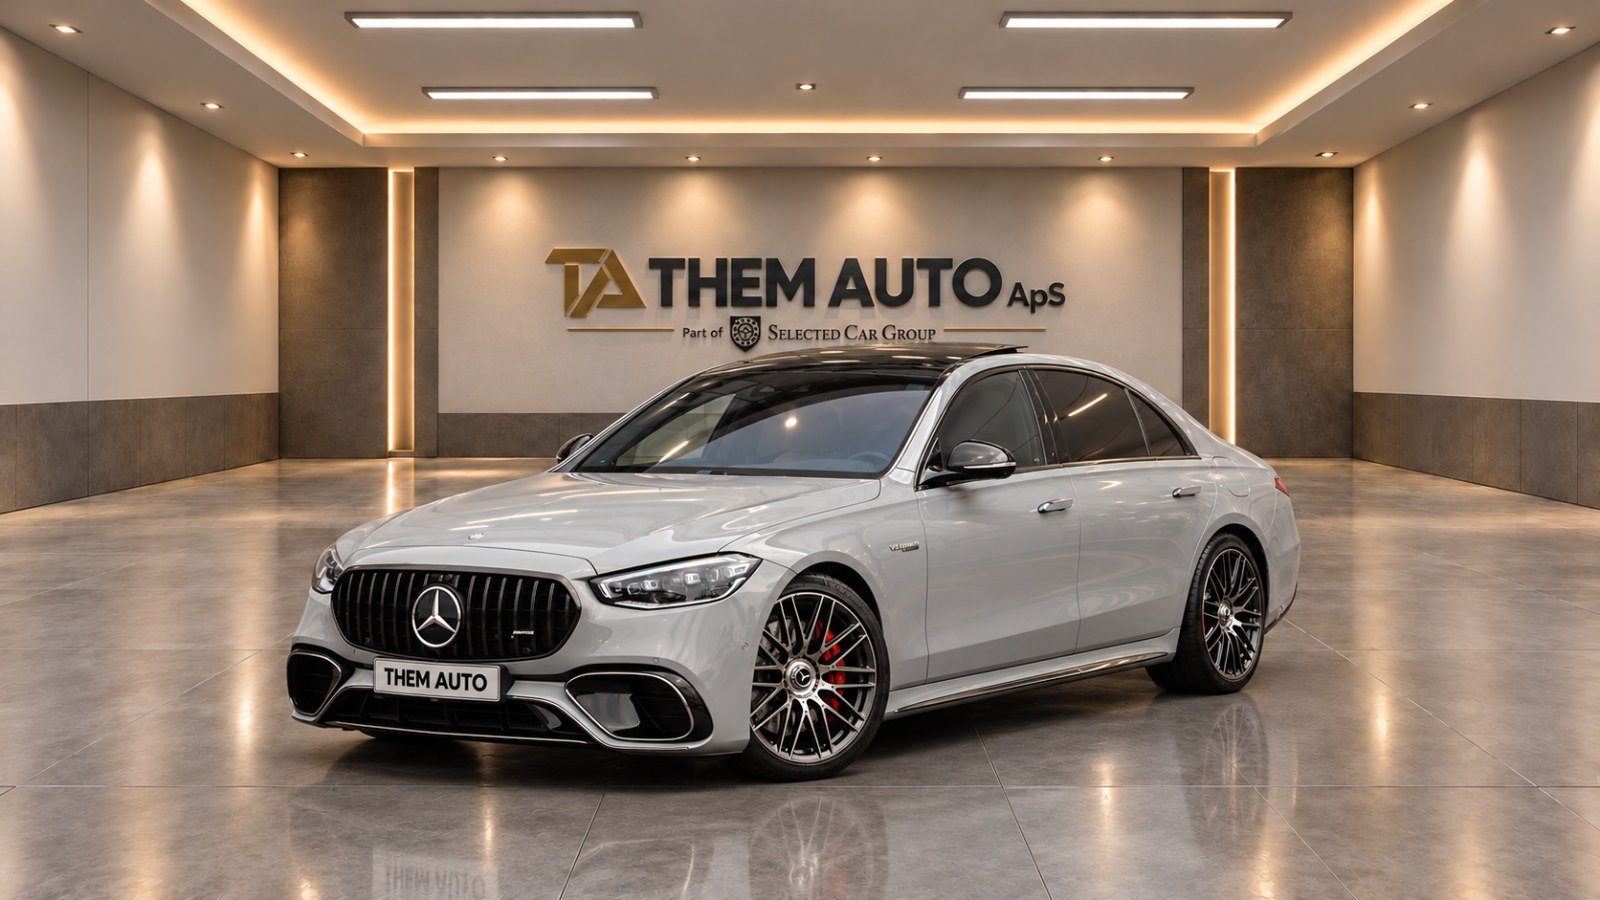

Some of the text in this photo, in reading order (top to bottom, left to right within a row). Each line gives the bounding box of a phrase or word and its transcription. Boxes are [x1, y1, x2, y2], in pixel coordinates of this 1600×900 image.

[648, 257, 1066, 313] THEM AUTO ApS
[682, 326, 724, 339] Part of
[768, 323, 937, 342] SELECTED CAR GROUP
[383, 666, 488, 692] THEM AUTO
